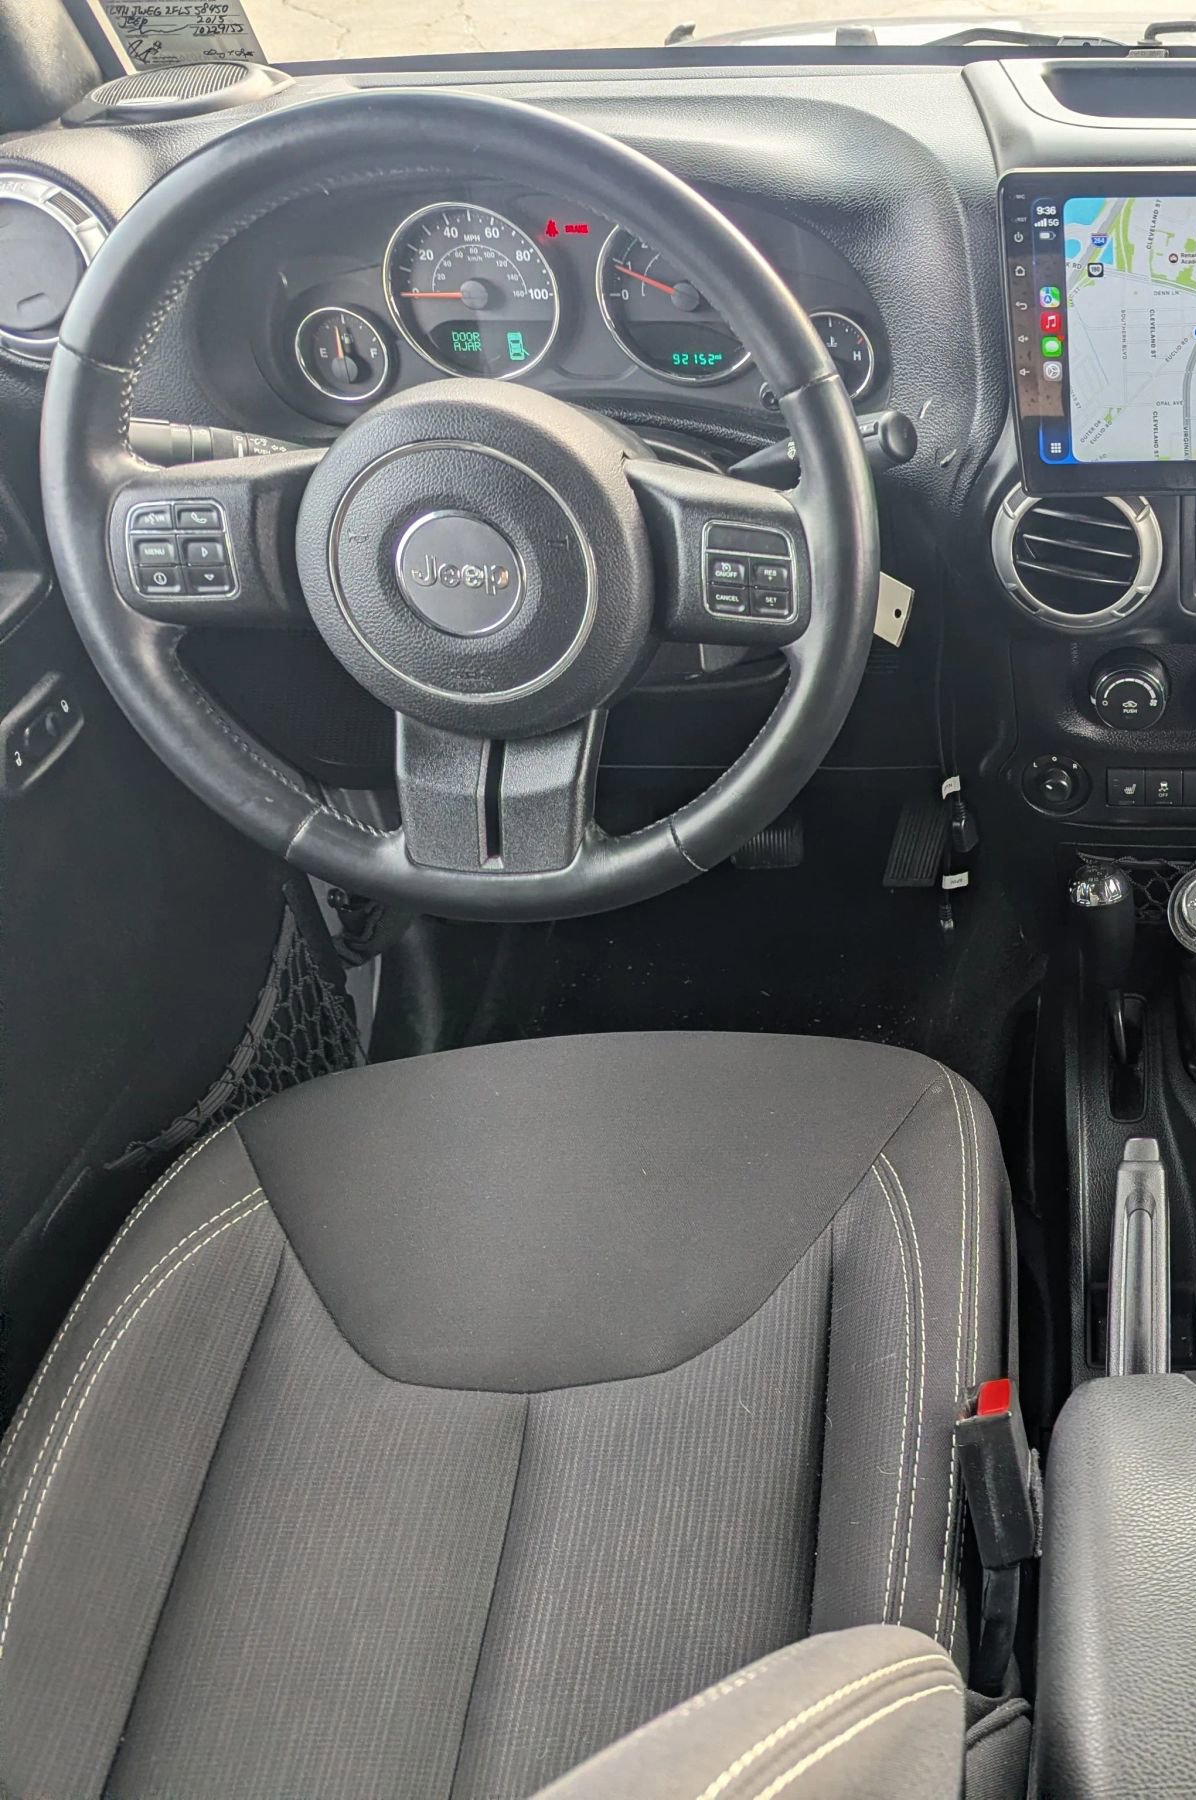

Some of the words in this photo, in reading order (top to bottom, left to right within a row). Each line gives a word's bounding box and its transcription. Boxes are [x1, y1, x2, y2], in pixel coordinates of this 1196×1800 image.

[1036, 206, 1057, 215] 9:36
[1048, 218, 1059, 227] 5G
[443, 226, 458, 239] 40
[484, 226, 500, 239] 60
[1146, 209, 1160, 250] CLEVELAND
[463, 234, 481, 242] MPH
[418, 249, 434, 261] 20
[516, 250, 531, 262] 80
[528, 288, 549, 300] 100
[621, 289, 630, 300] 0
[1149, 308, 1157, 348] CLEVELAND
[452, 331, 481, 342] DOOR
[453, 342, 482, 352] AJAR
[319, 348, 328, 358] E
[370, 348, 378, 358] F
[852, 350, 862, 361] H
[144, 548, 165, 556] MENU
[410, 554, 510, 595] Jeep
[716, 594, 740, 602] CANCEL
